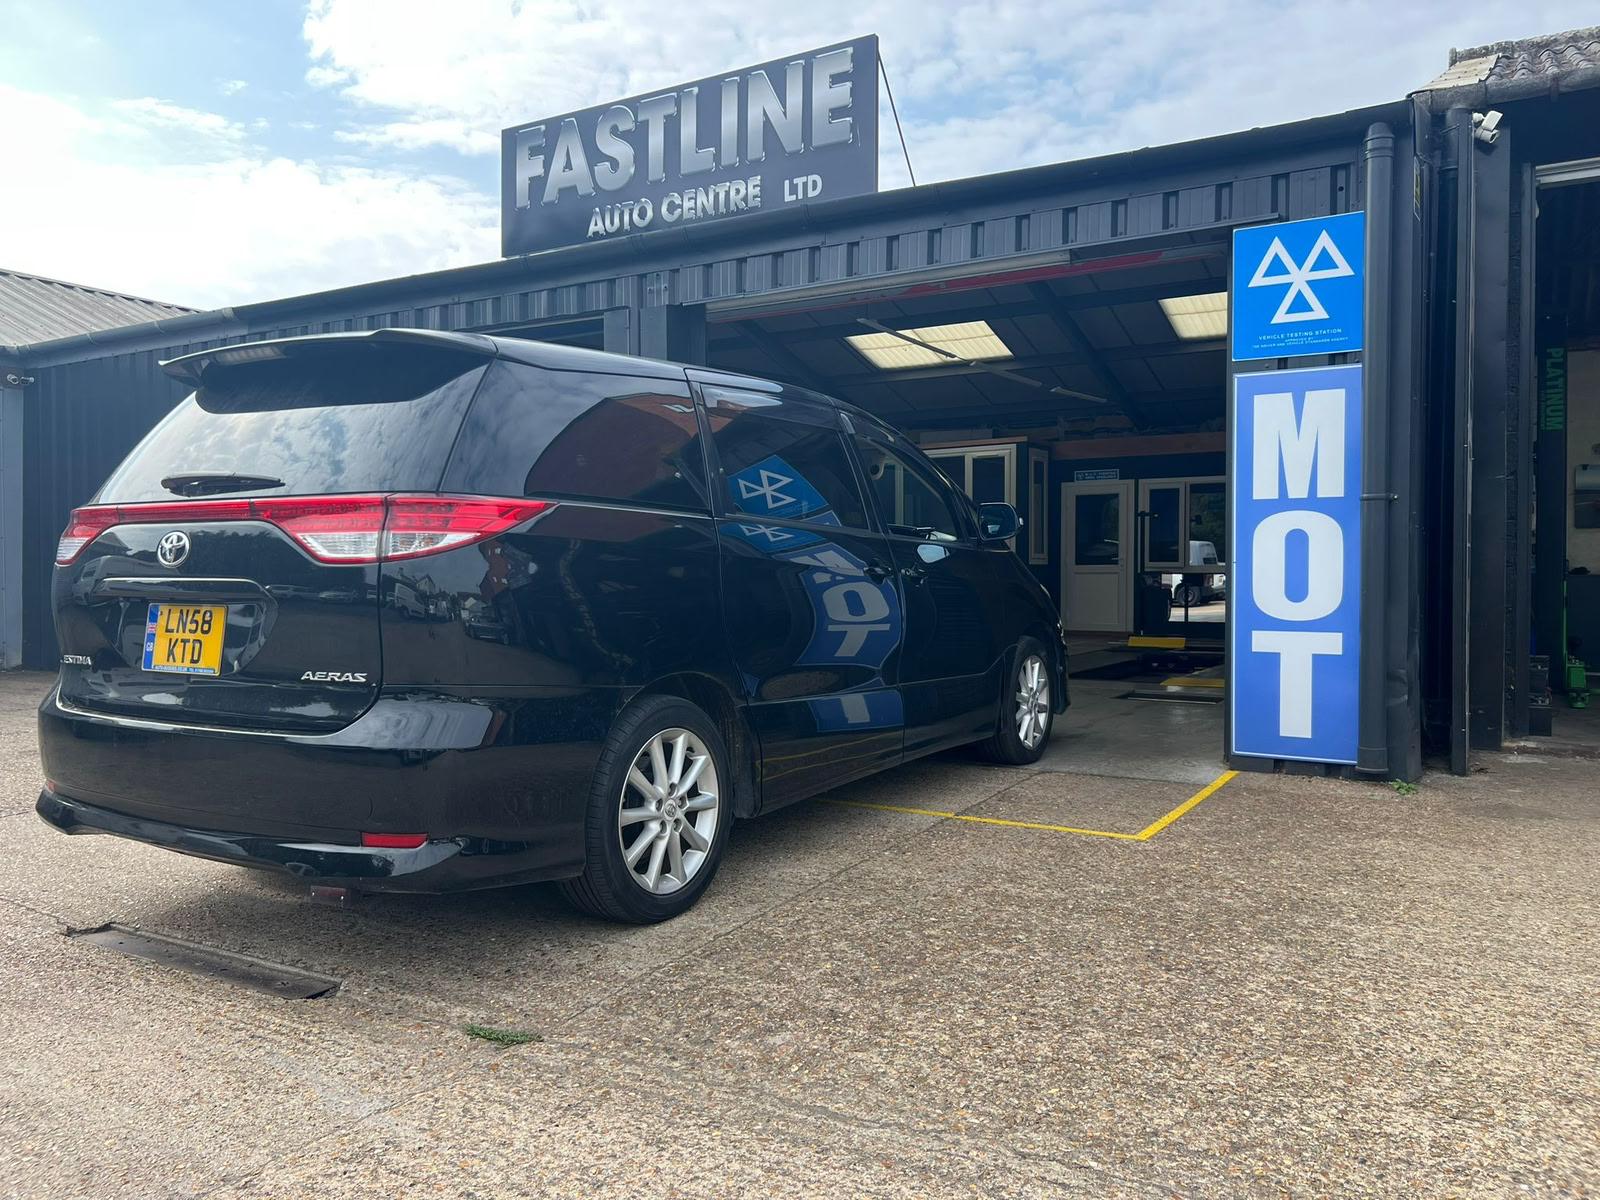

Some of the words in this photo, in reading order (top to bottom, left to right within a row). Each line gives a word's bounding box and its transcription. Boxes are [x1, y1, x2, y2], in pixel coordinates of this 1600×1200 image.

[515, 46, 854, 210] FASTLINE
[587, 197, 654, 238] AUTO
[661, 175, 762, 222] CENTRE
[784, 174, 823, 203] LTD
[1546, 347, 1564, 431] PLATINUM
[1252, 389, 1346, 738] MOT
[165, 608, 213, 635] LN58
[63, 654, 92, 666] ESTIMA
[166, 638, 203, 664] KTD
[301, 671, 369, 683] AERAS
